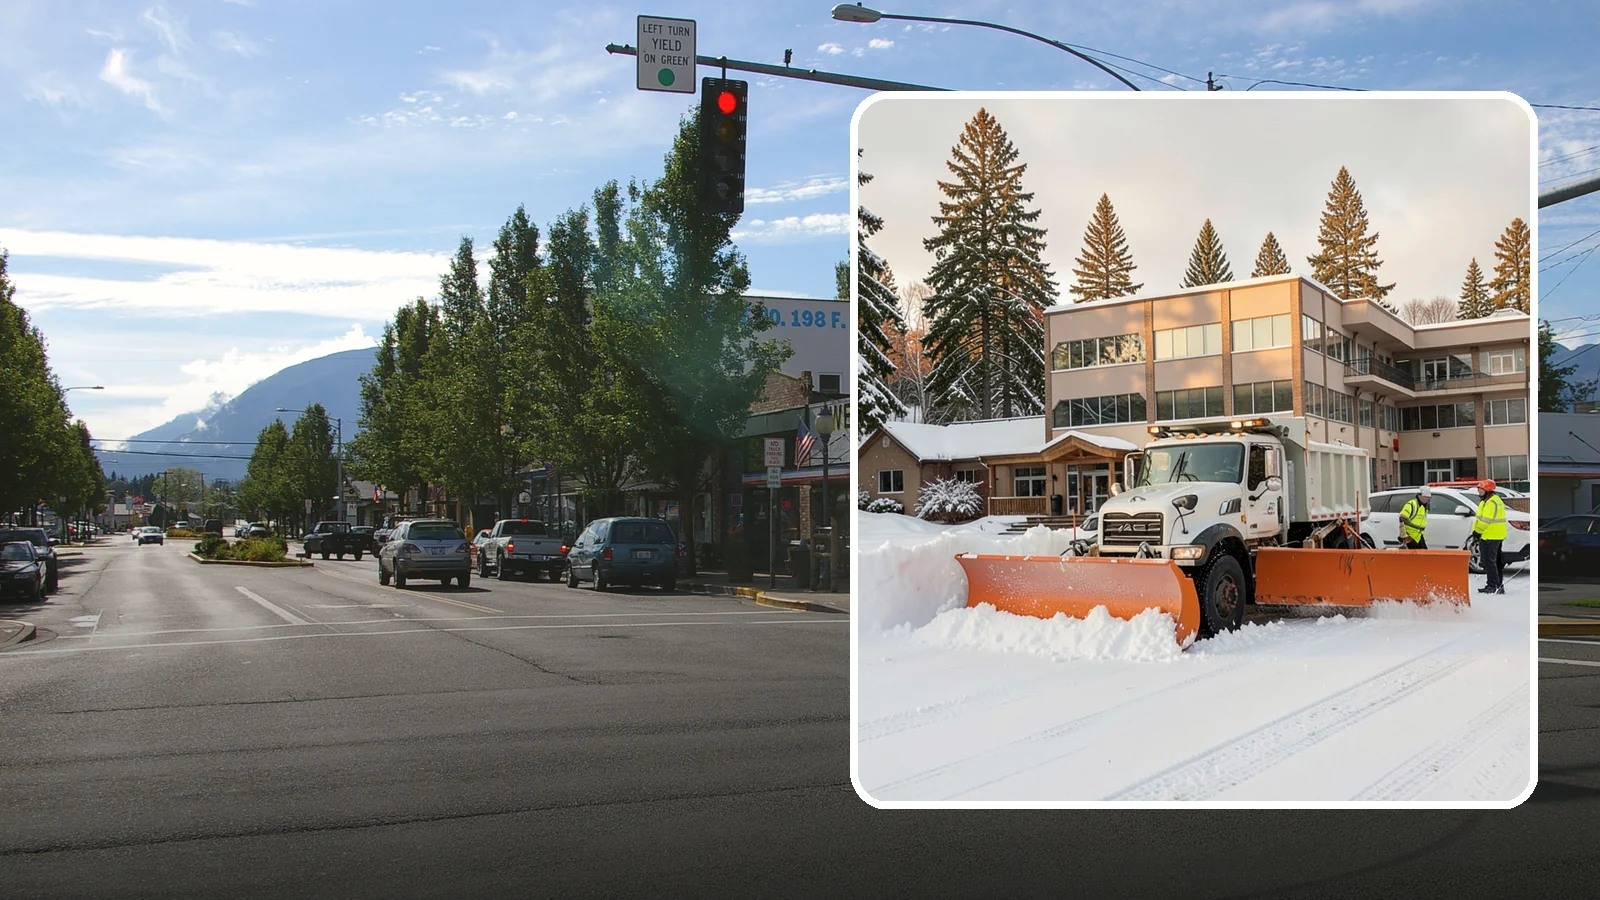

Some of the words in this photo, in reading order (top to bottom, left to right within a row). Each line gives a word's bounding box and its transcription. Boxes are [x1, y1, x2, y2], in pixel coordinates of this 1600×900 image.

[643, 23, 663, 34] LEFT
[668, 25, 690, 37] TURN
[652, 38, 682, 52] YIELD
[644, 53, 656, 63] ON
[661, 55, 689, 66] GREEN
[791, 309, 826, 328] 198
[831, 311, 846, 329] F.
